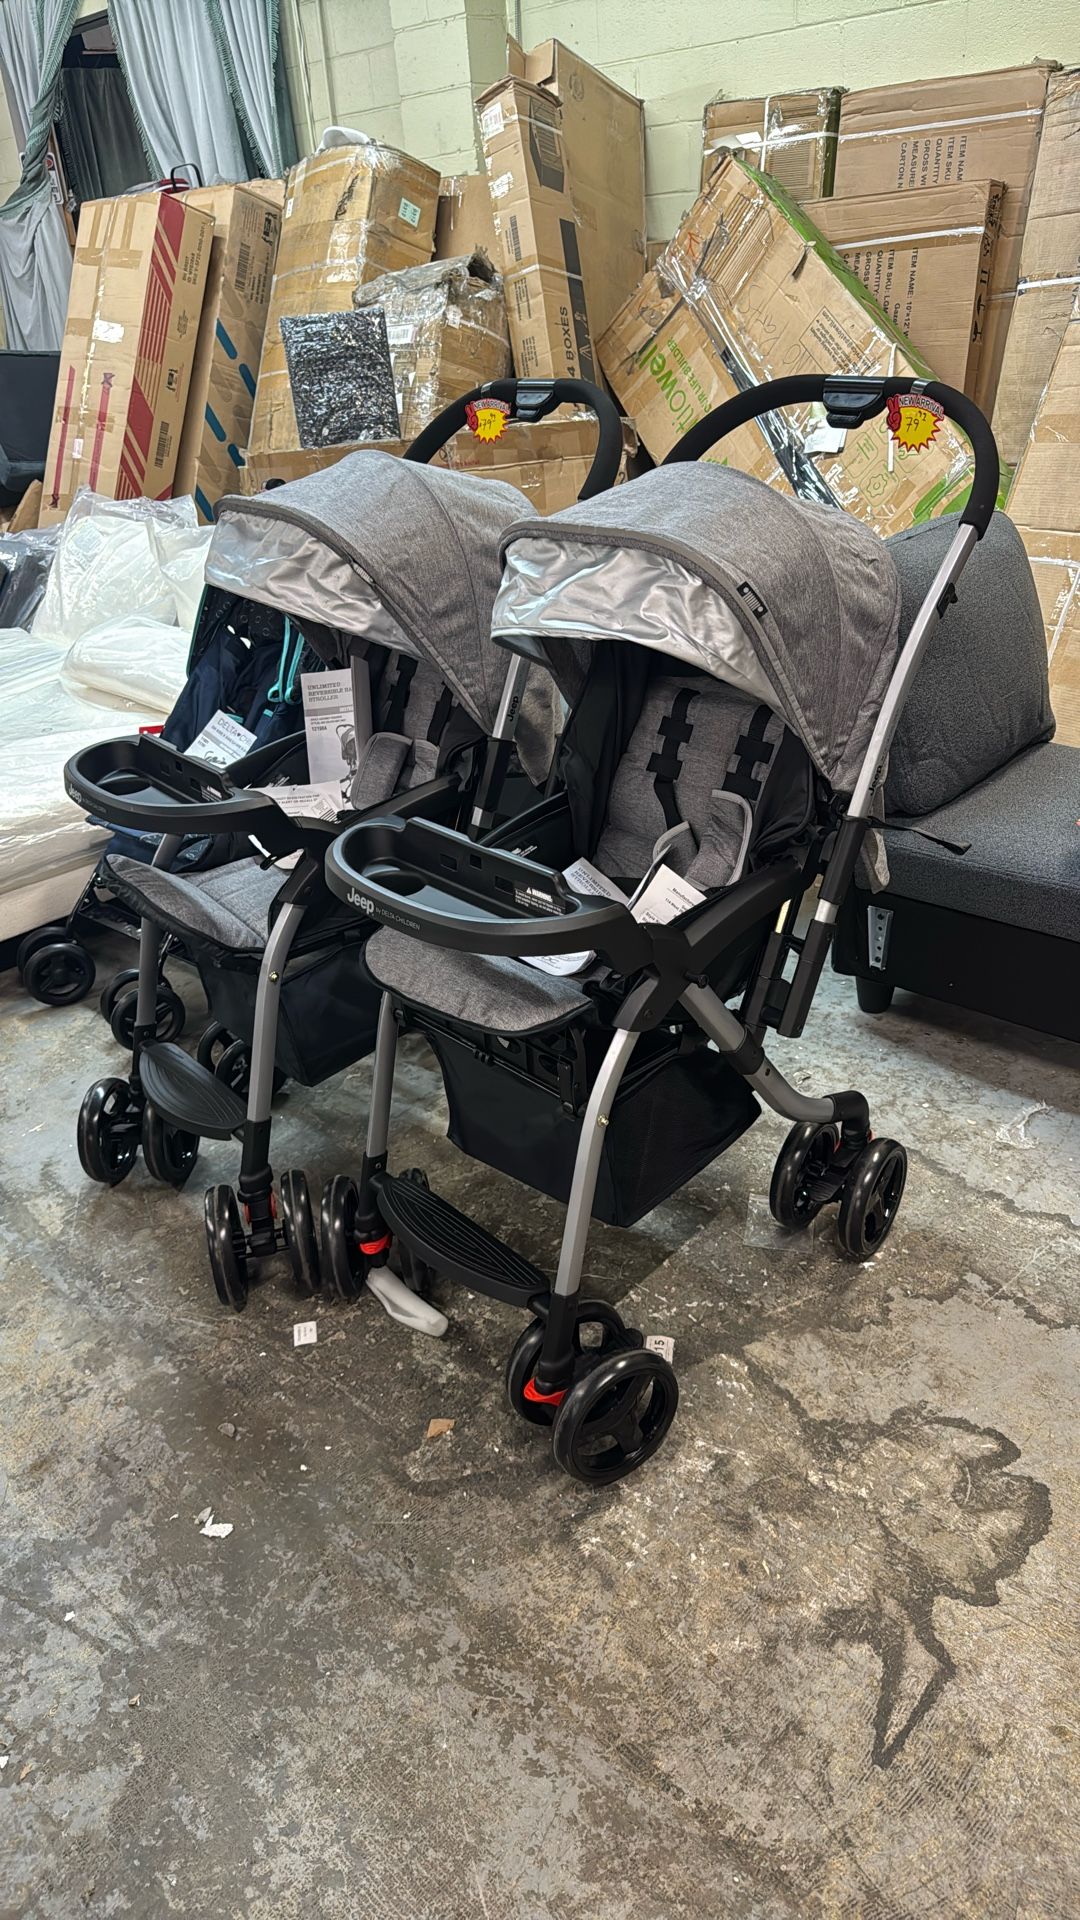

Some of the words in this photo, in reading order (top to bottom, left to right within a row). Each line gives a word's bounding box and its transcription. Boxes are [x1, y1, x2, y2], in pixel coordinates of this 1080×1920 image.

[897, 141, 908, 180] CARTON
[921, 139, 931, 173] GROSS
[932, 138, 943, 184] QUANTITY
[947, 136, 955, 159] ITEM
[959, 135, 968, 158] ITEM
[863, 250, 872, 280] GROSS
[887, 249, 895, 272] ITEM
[910, 246, 919, 269] ITEM
[907, 270, 917, 299] NAME:
[560, 306, 574, 361] BOXES
[667, 338, 689, 375] BUILDER
[567, 366, 576, 378] 4
[899, 396, 916, 406] NEW
[917, 396, 945, 418] ARRIVAL
[307, 682, 341, 691] UNLIMITED
[507, 696, 519, 722] Jeep
[577, 866, 612, 897] UNLIMITED
[346, 887, 375, 914] Jeep
[382, 909, 395, 920] DELTA
[395, 914, 421, 930] CHILDREN
